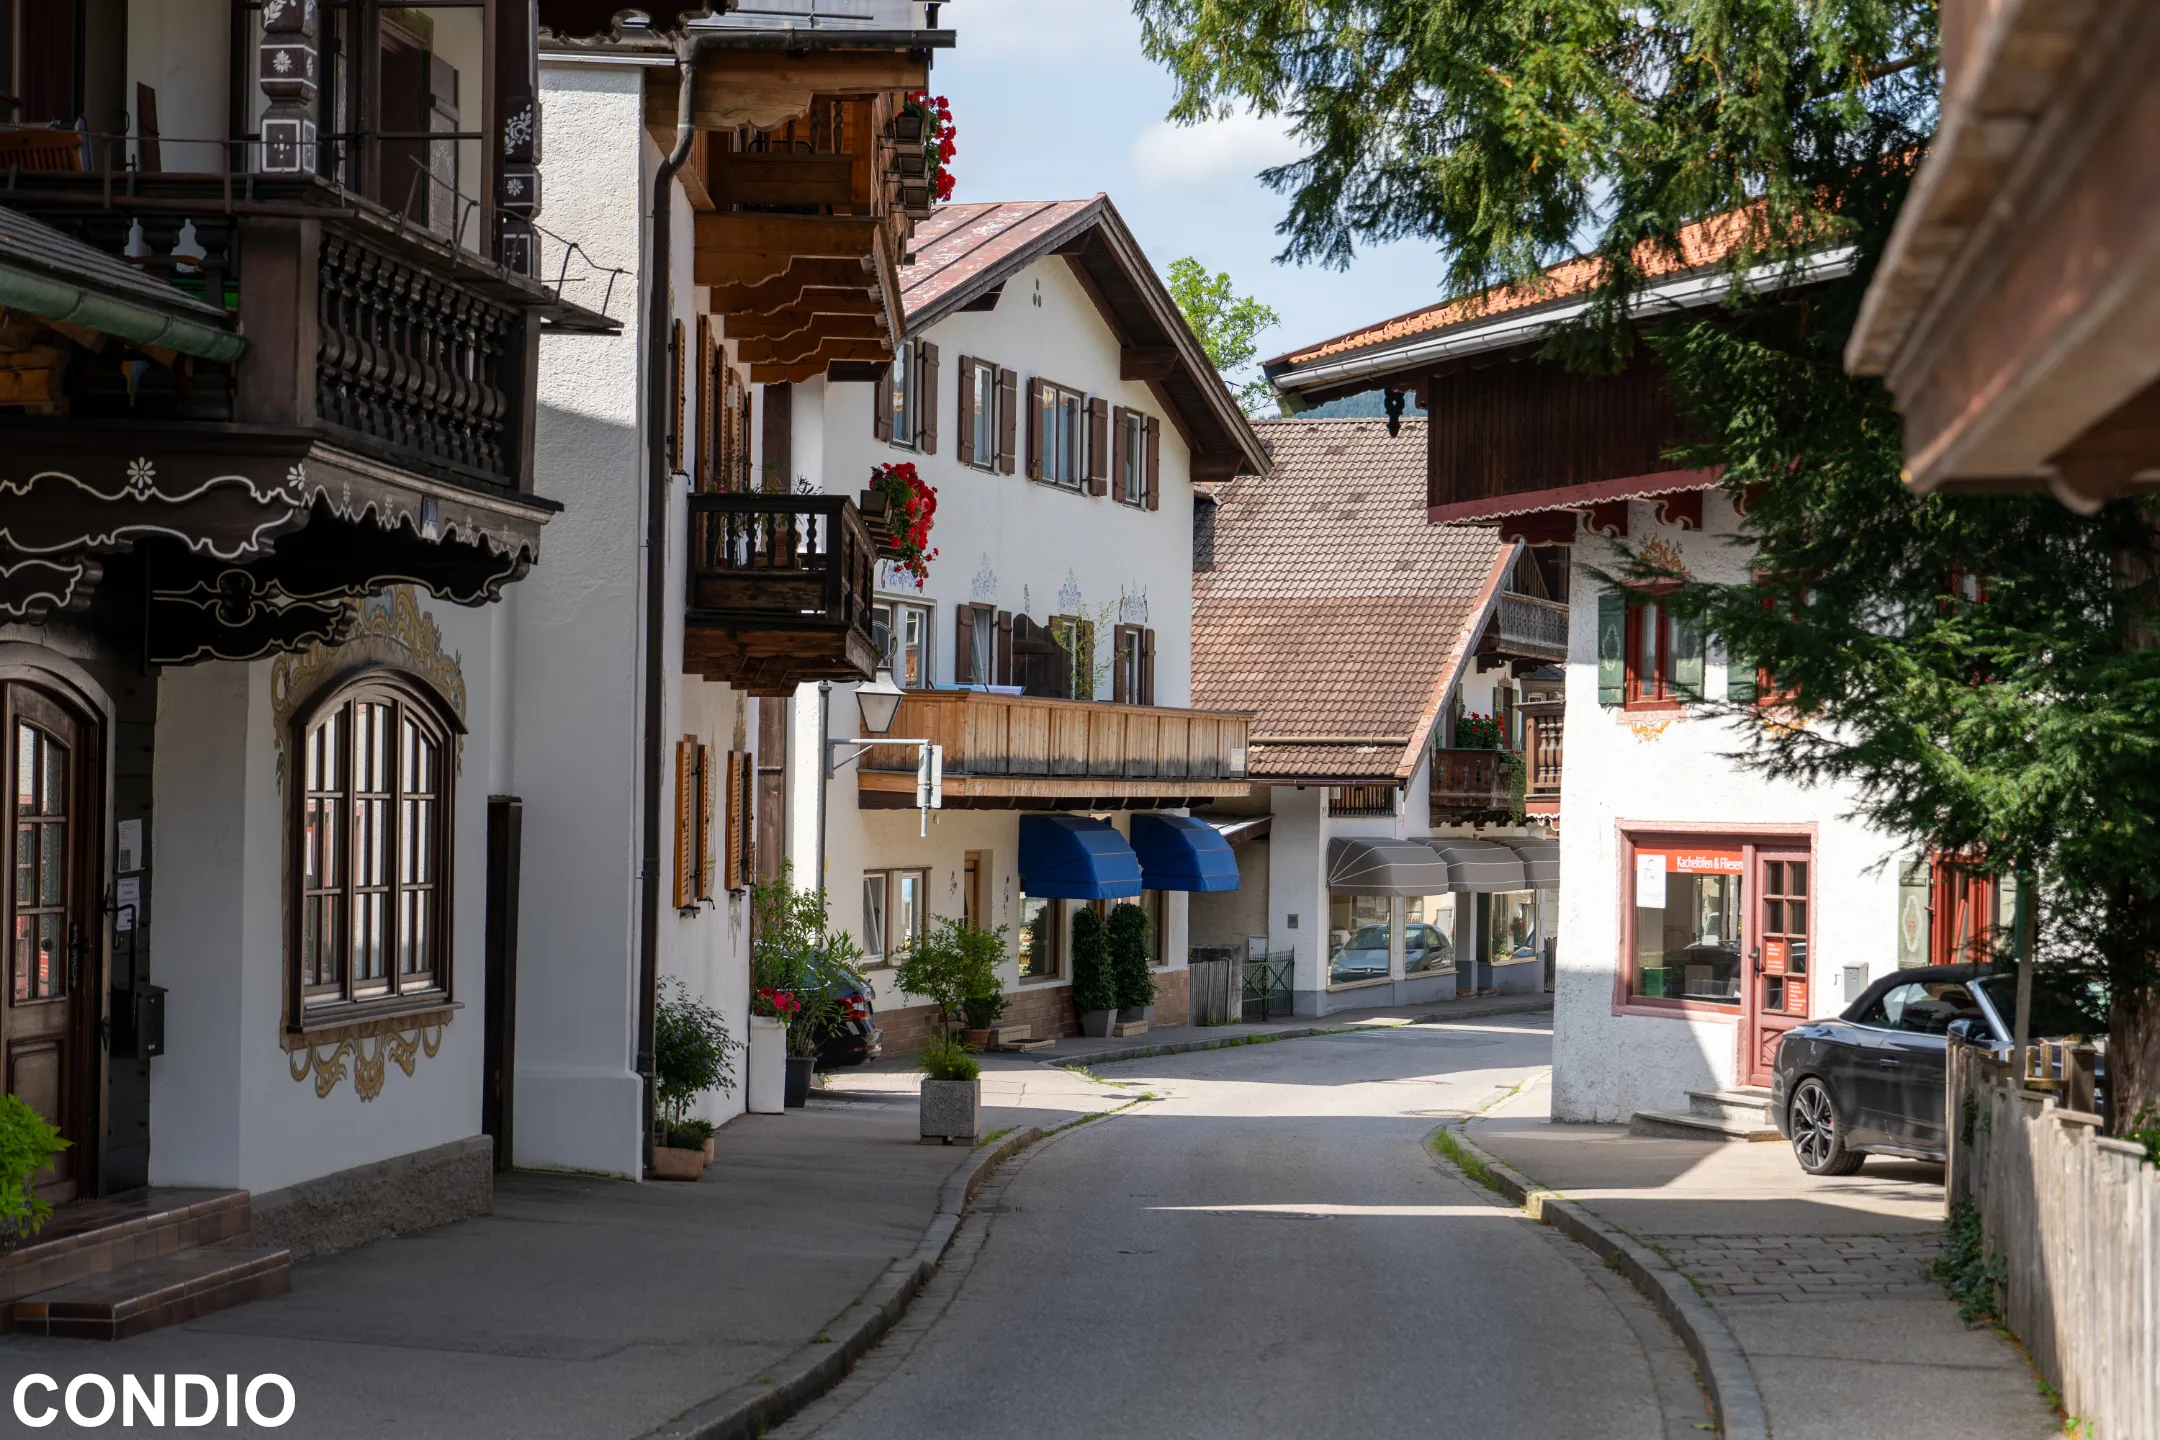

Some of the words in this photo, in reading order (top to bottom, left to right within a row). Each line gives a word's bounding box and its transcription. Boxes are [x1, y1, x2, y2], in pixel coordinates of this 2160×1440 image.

[1677, 856, 1712, 868] Kachelöfen
[1714, 857, 1719, 869] &
[1720, 857, 1743, 870] Fliesen
